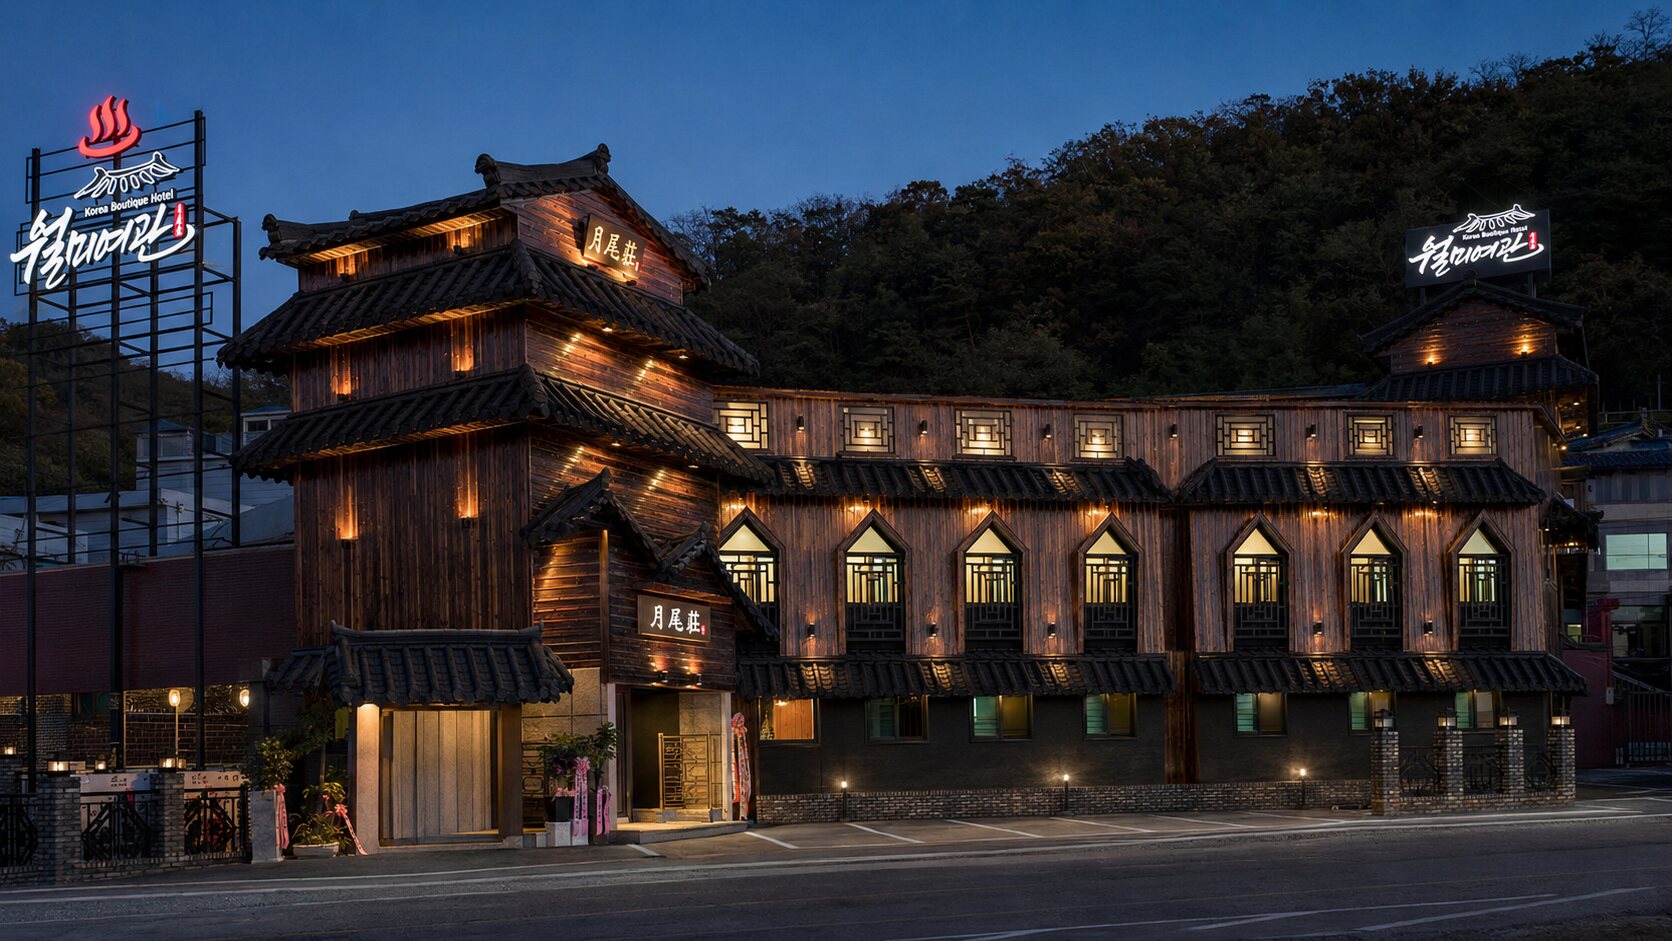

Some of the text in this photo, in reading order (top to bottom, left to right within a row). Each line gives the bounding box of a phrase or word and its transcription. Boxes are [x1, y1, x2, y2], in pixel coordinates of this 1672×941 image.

[84, 188, 174, 217] Korea Boutique Hotel
[10, 203, 196, 290] 월미여관
[1408, 232, 1545, 278] 월미여관
